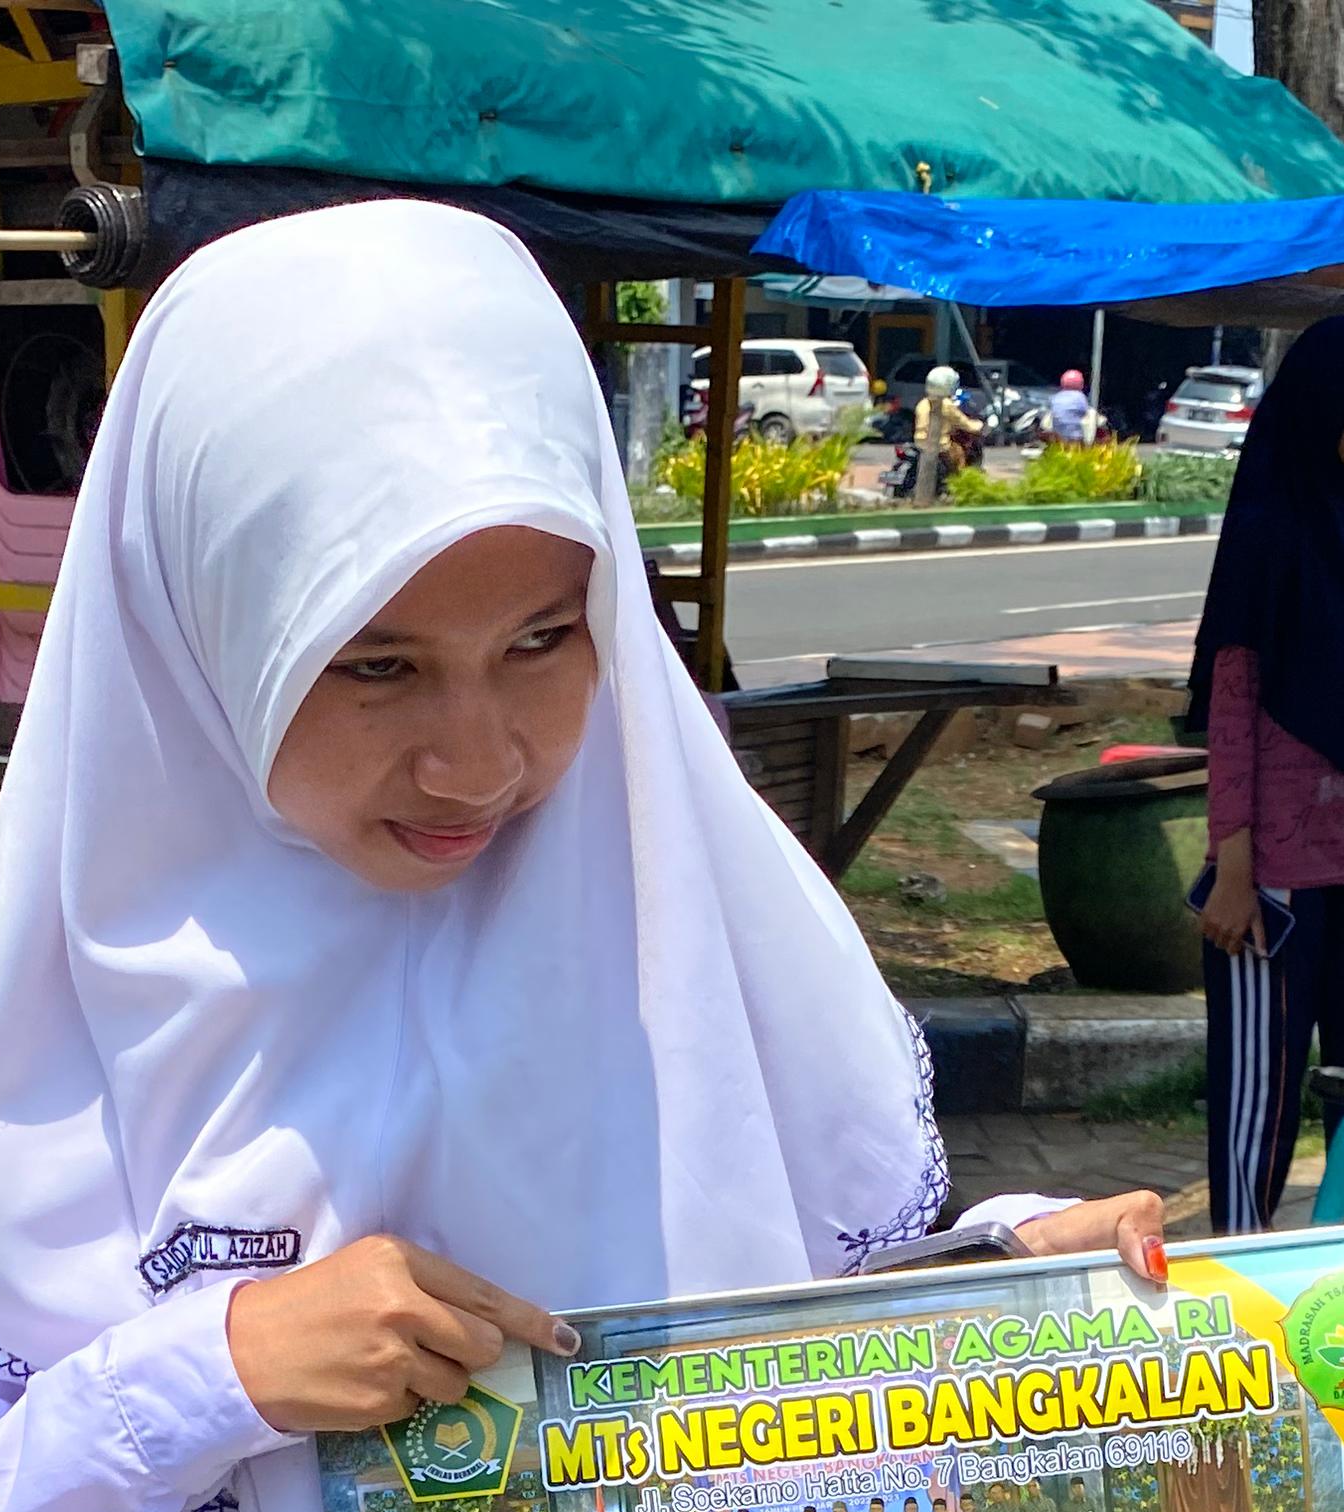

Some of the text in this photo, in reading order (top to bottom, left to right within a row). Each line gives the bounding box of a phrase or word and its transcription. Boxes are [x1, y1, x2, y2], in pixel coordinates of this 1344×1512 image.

[228, 1235, 288, 1260] AZIZAH
[570, 1295, 1231, 1407] KEMENTERIAN AGAMA RI
[544, 1345, 1275, 1485] MTs NEGERI BANGKALAN
[672, 1478, 799, 1512] Soekarno
[805, 1470, 878, 1499] Hatta
[883, 1461, 929, 1491] No.
[937, 1458, 953, 1484] 7
[959, 1446, 1101, 1485] Bangkalan
[1105, 1431, 1192, 1466] 69116
